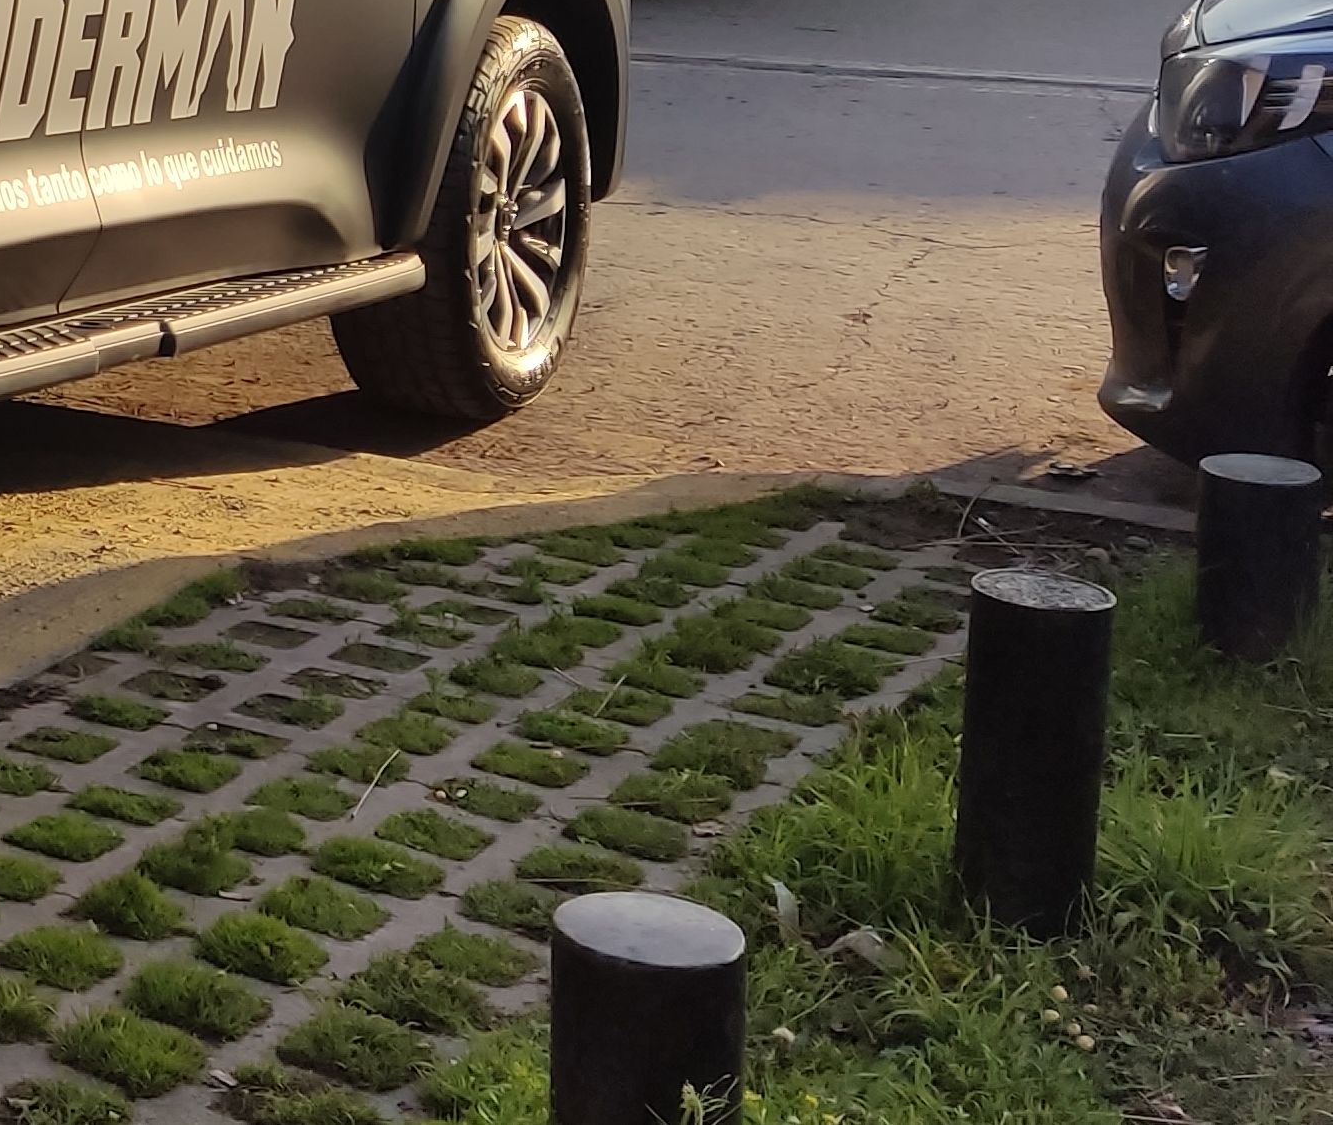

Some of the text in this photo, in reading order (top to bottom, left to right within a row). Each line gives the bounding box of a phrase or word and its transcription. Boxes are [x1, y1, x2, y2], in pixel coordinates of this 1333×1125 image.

[27, 163, 88, 208] tanto
[90, 161, 143, 197] como
[140, 150, 163, 188] lo
[163, 154, 200, 192] que
[200, 137, 283, 177] cuidamos
